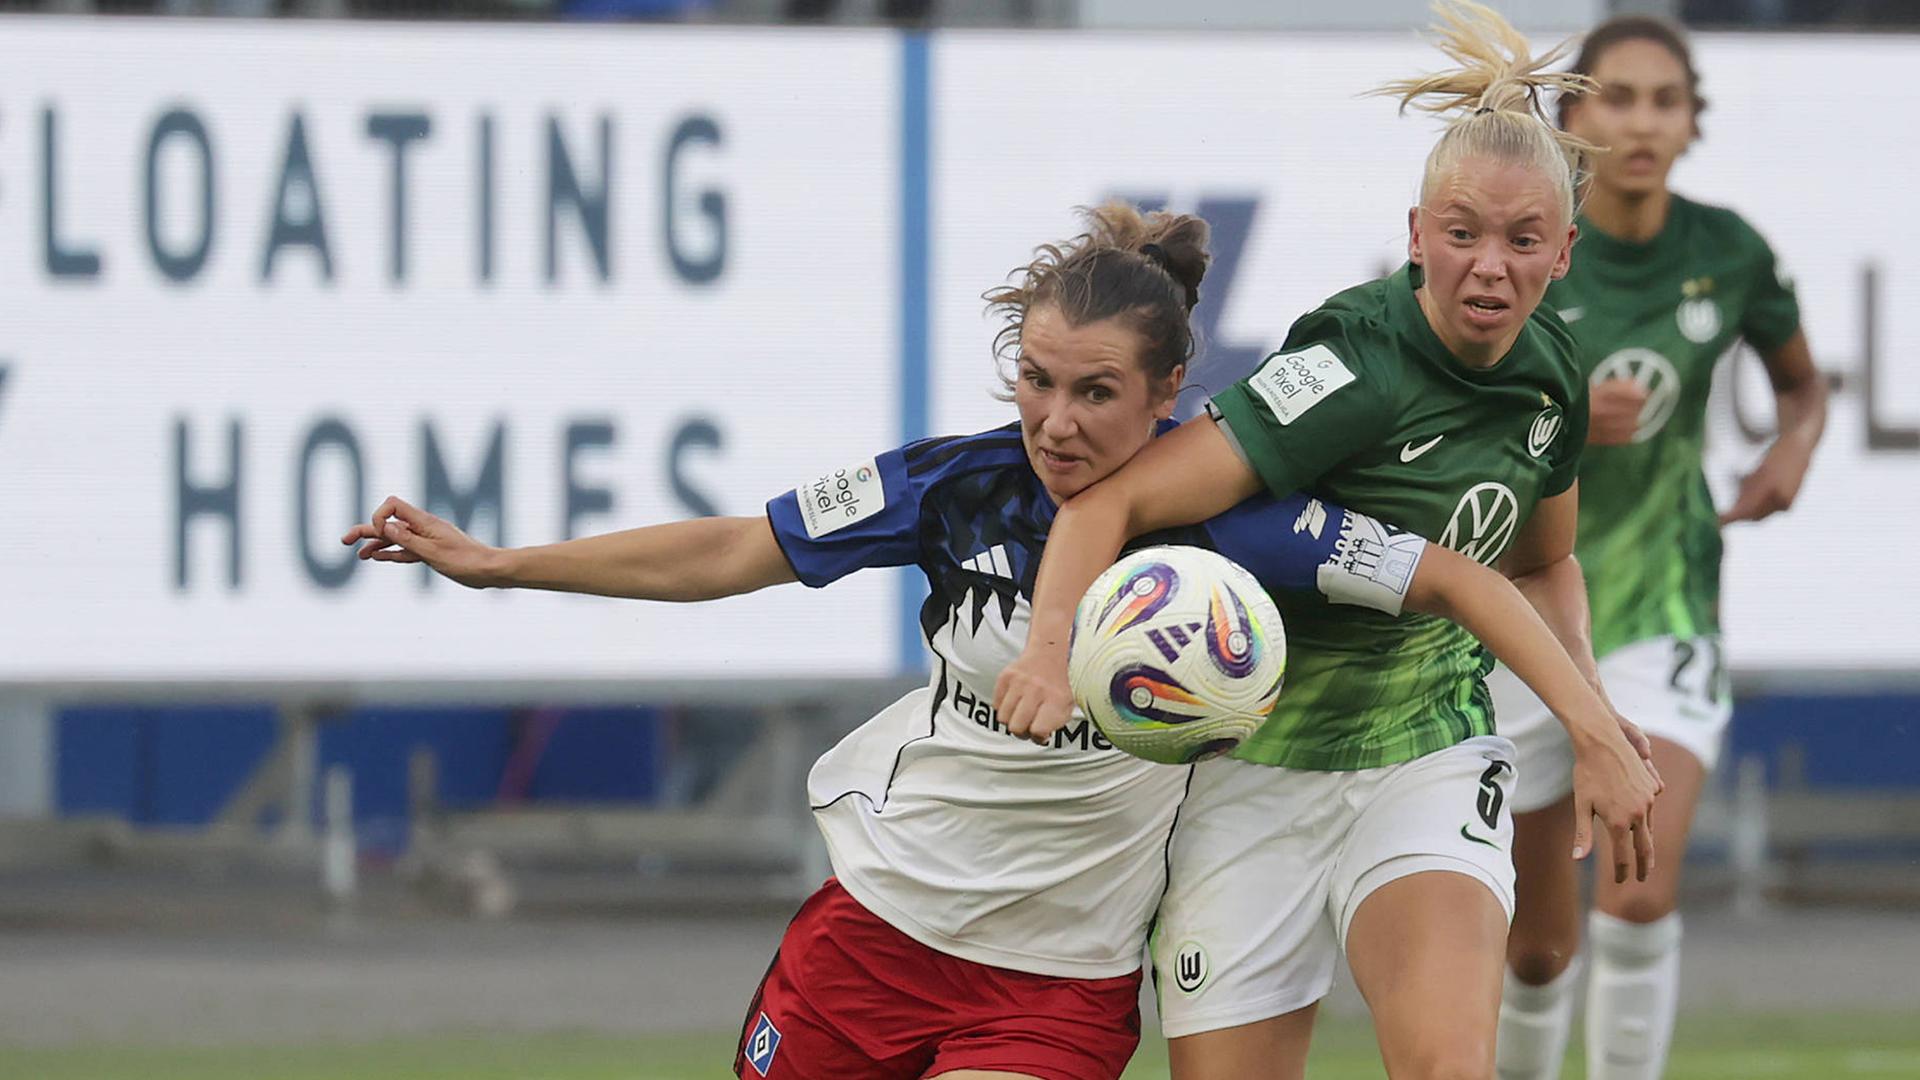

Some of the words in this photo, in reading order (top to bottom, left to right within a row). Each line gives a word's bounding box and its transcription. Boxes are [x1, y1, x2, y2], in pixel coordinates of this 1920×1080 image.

[0, 106, 729, 286] LOATING
[1270, 367, 1302, 399] Pixel
[1286, 355, 1324, 394] Google
[1476, 755, 1513, 831] 5
